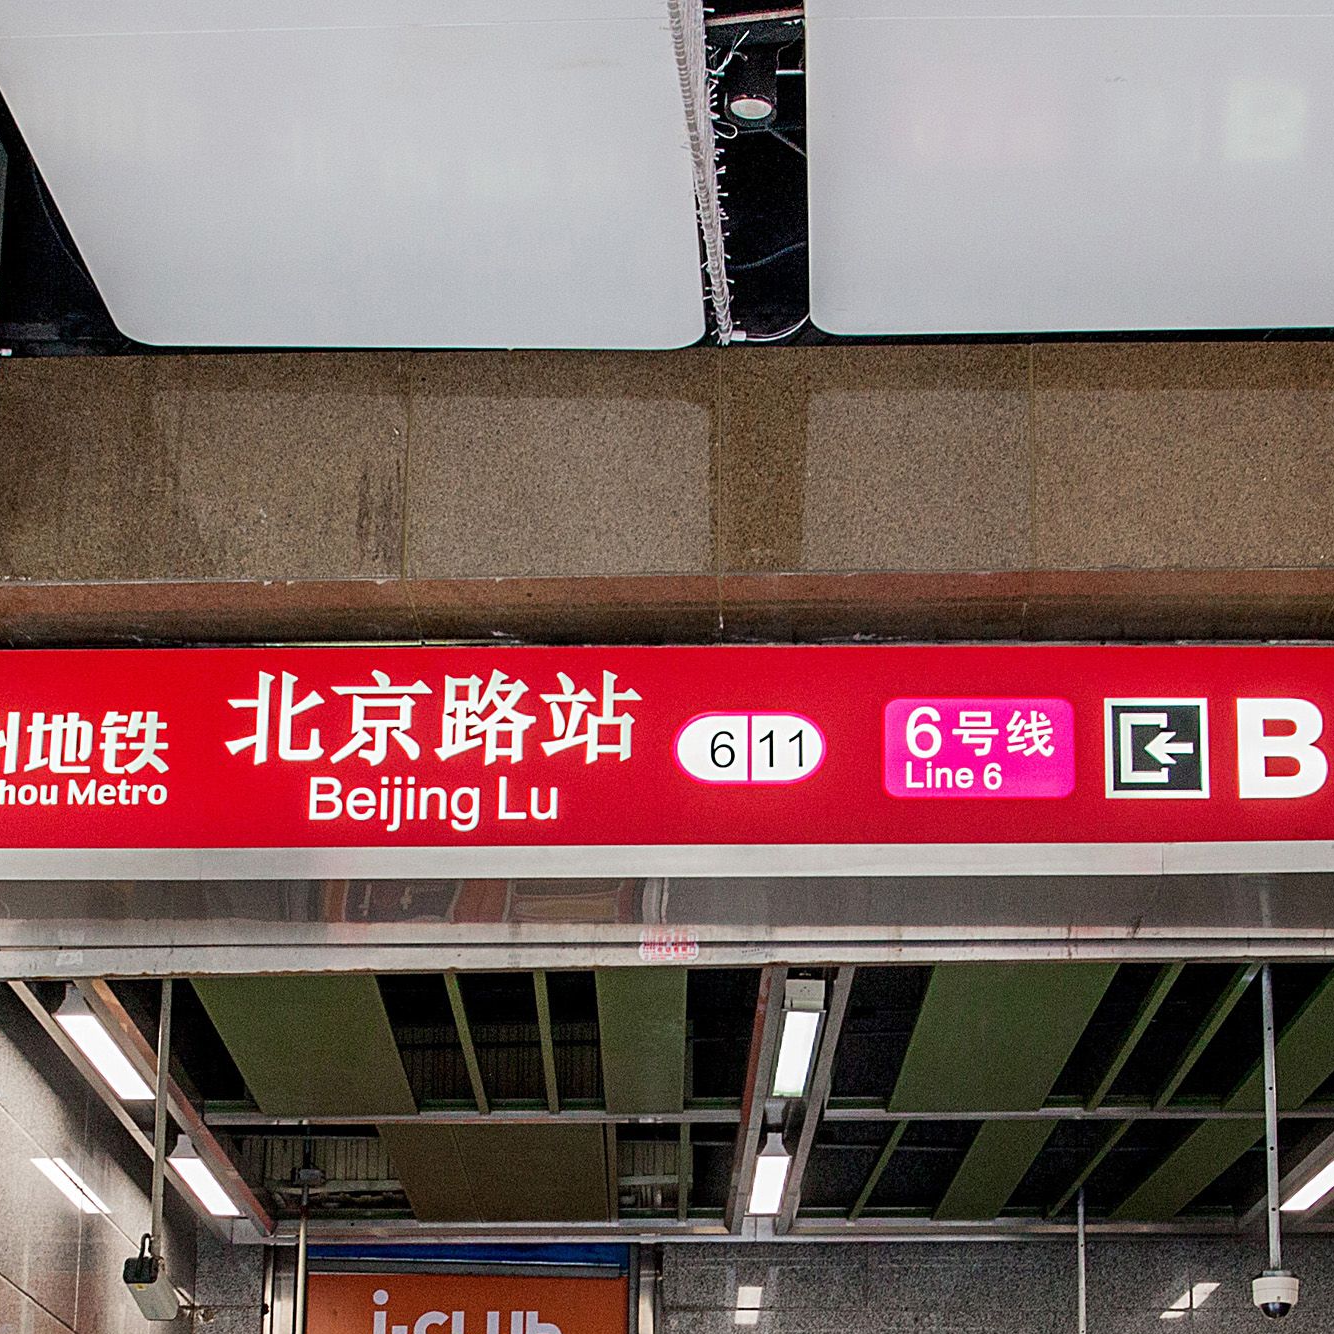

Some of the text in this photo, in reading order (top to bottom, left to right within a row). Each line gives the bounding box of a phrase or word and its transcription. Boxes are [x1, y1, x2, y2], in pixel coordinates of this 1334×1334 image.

[225, 668, 644, 767] 北京路站
[906, 705, 1055, 759] 6号线
[905, 760, 1003, 790] Line 6
[1236, 697, 1330, 800] B
[66, 779, 167, 806] Metro
[308, 775, 558, 831] Beijing Lu
